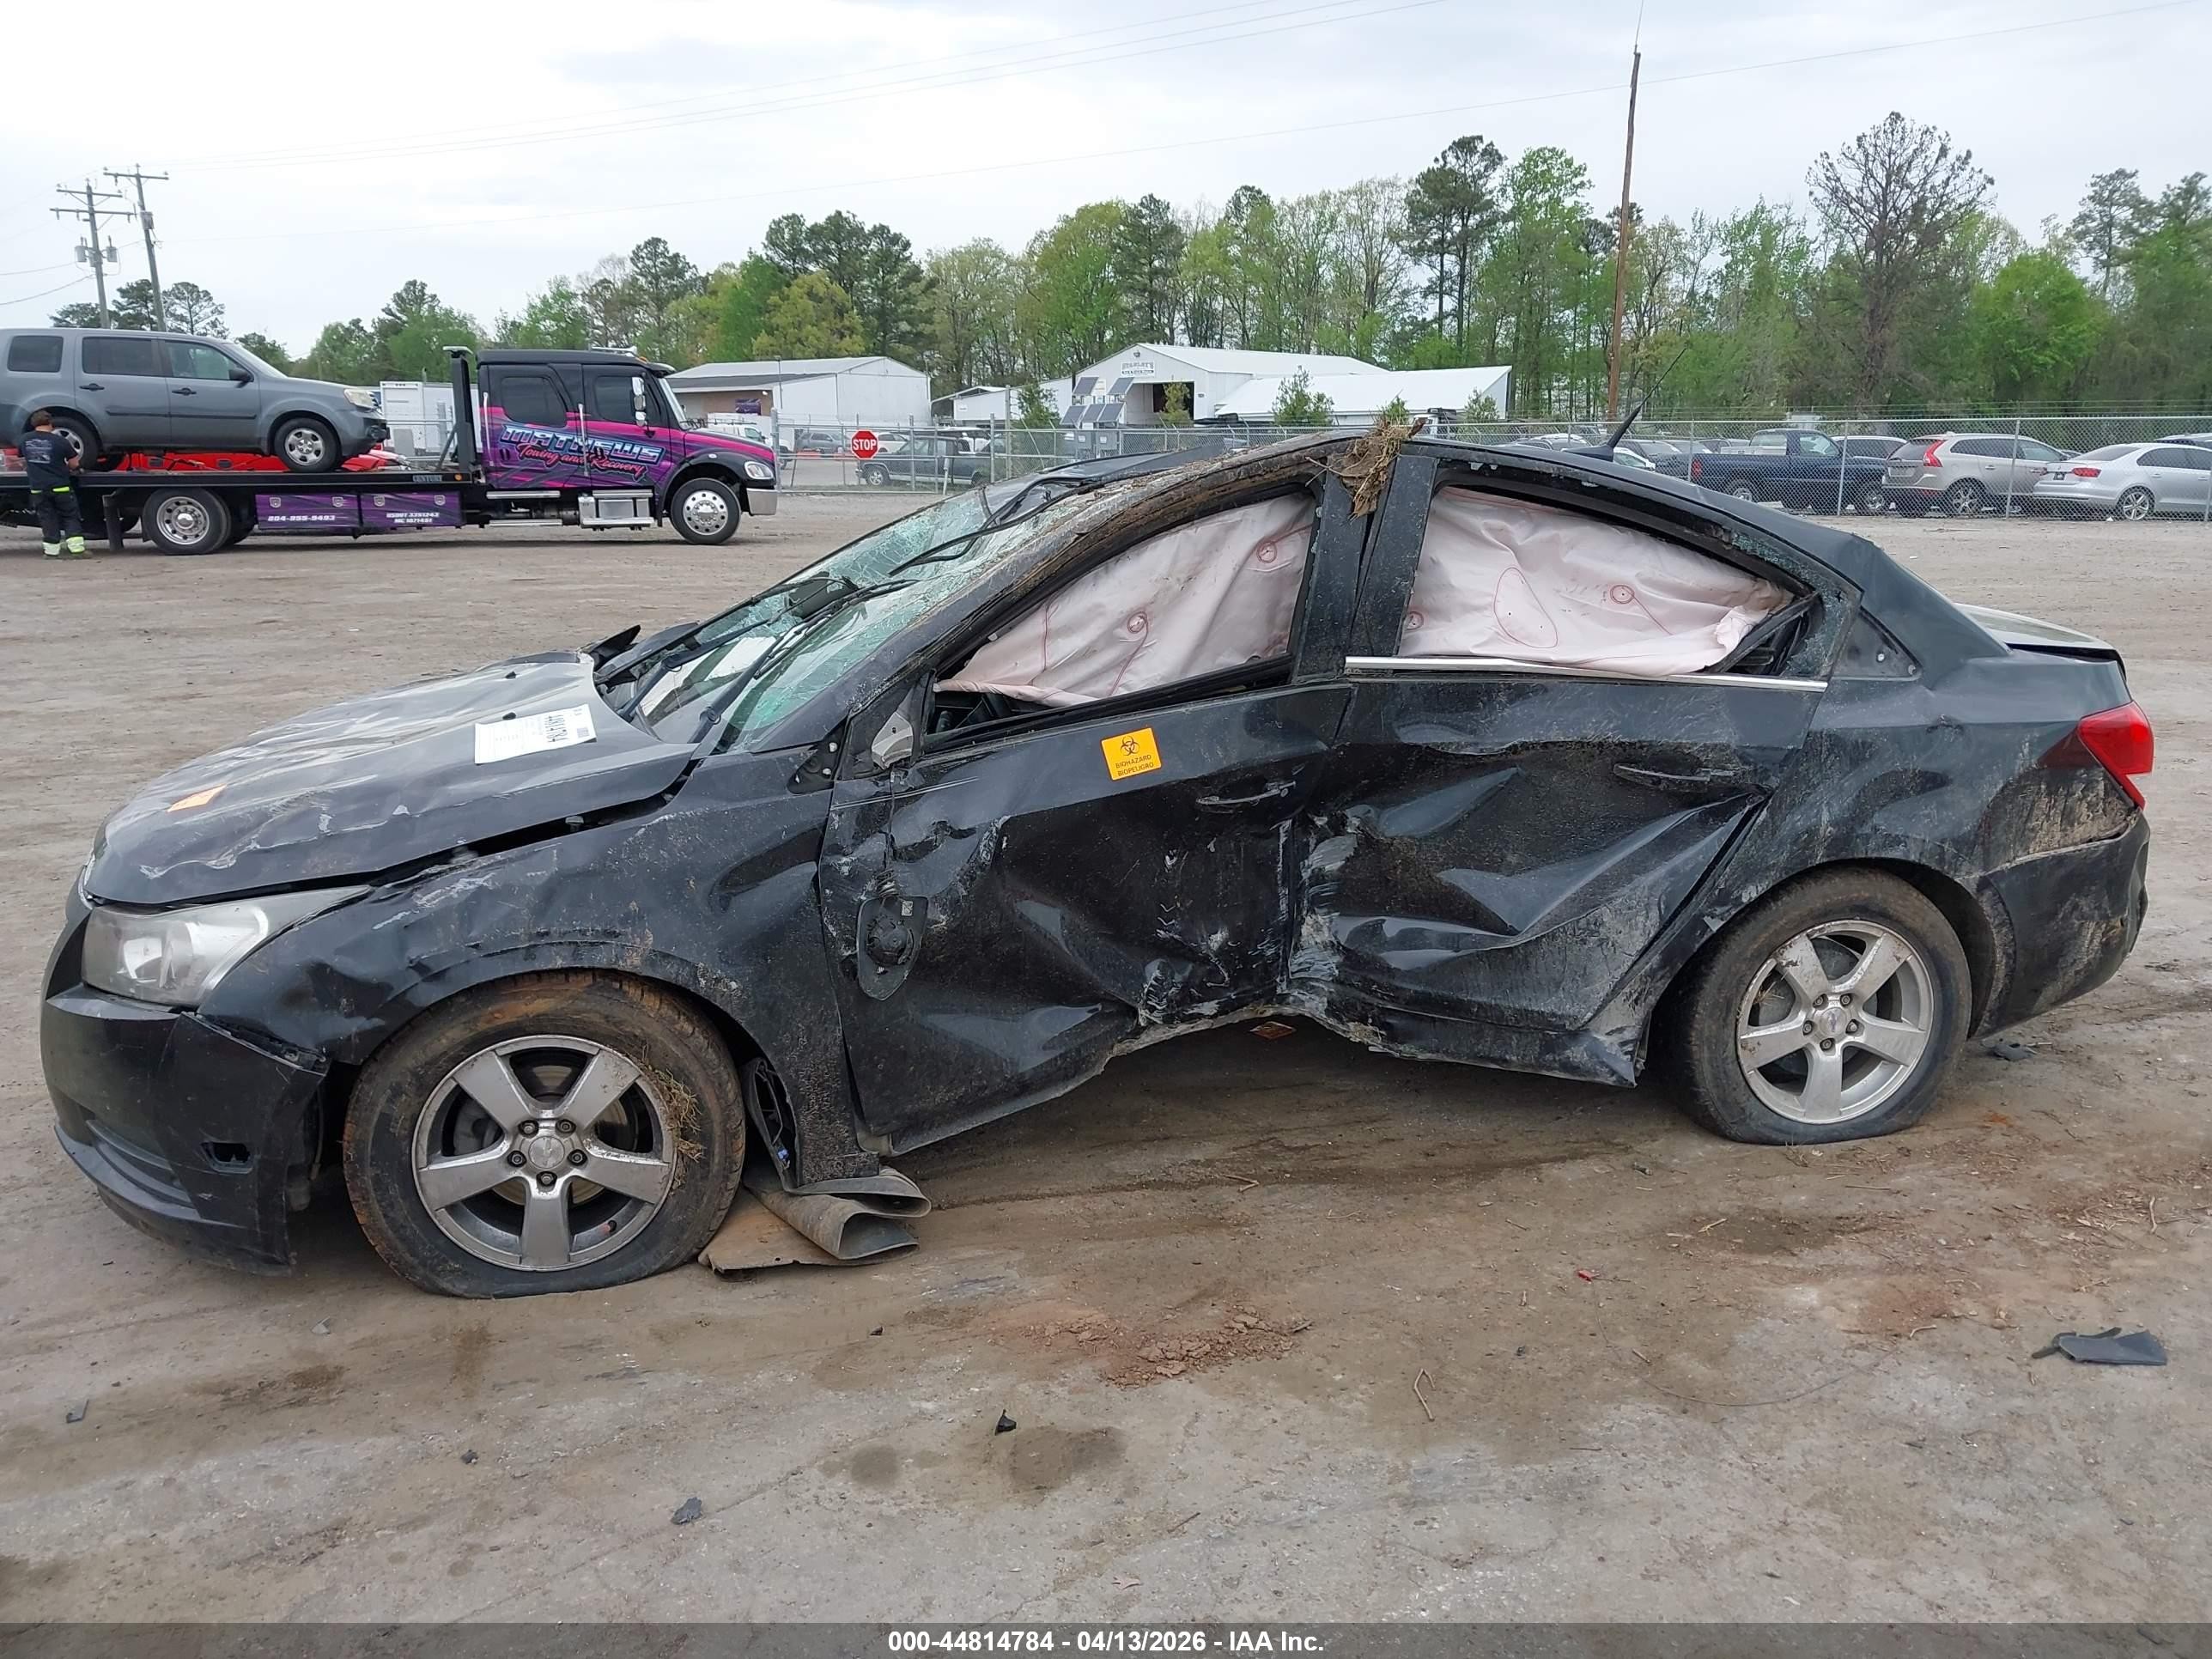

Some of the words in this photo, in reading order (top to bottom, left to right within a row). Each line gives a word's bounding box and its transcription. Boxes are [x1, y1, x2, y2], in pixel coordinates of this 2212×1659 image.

[853, 439, 877, 451] STOP
[517, 442, 560, 468] Towing
[587, 453, 645, 479] Recovery
[1115, 754, 1152, 769] BIOHAZARD
[1117, 762, 1154, 776] BIOPELIGRO
